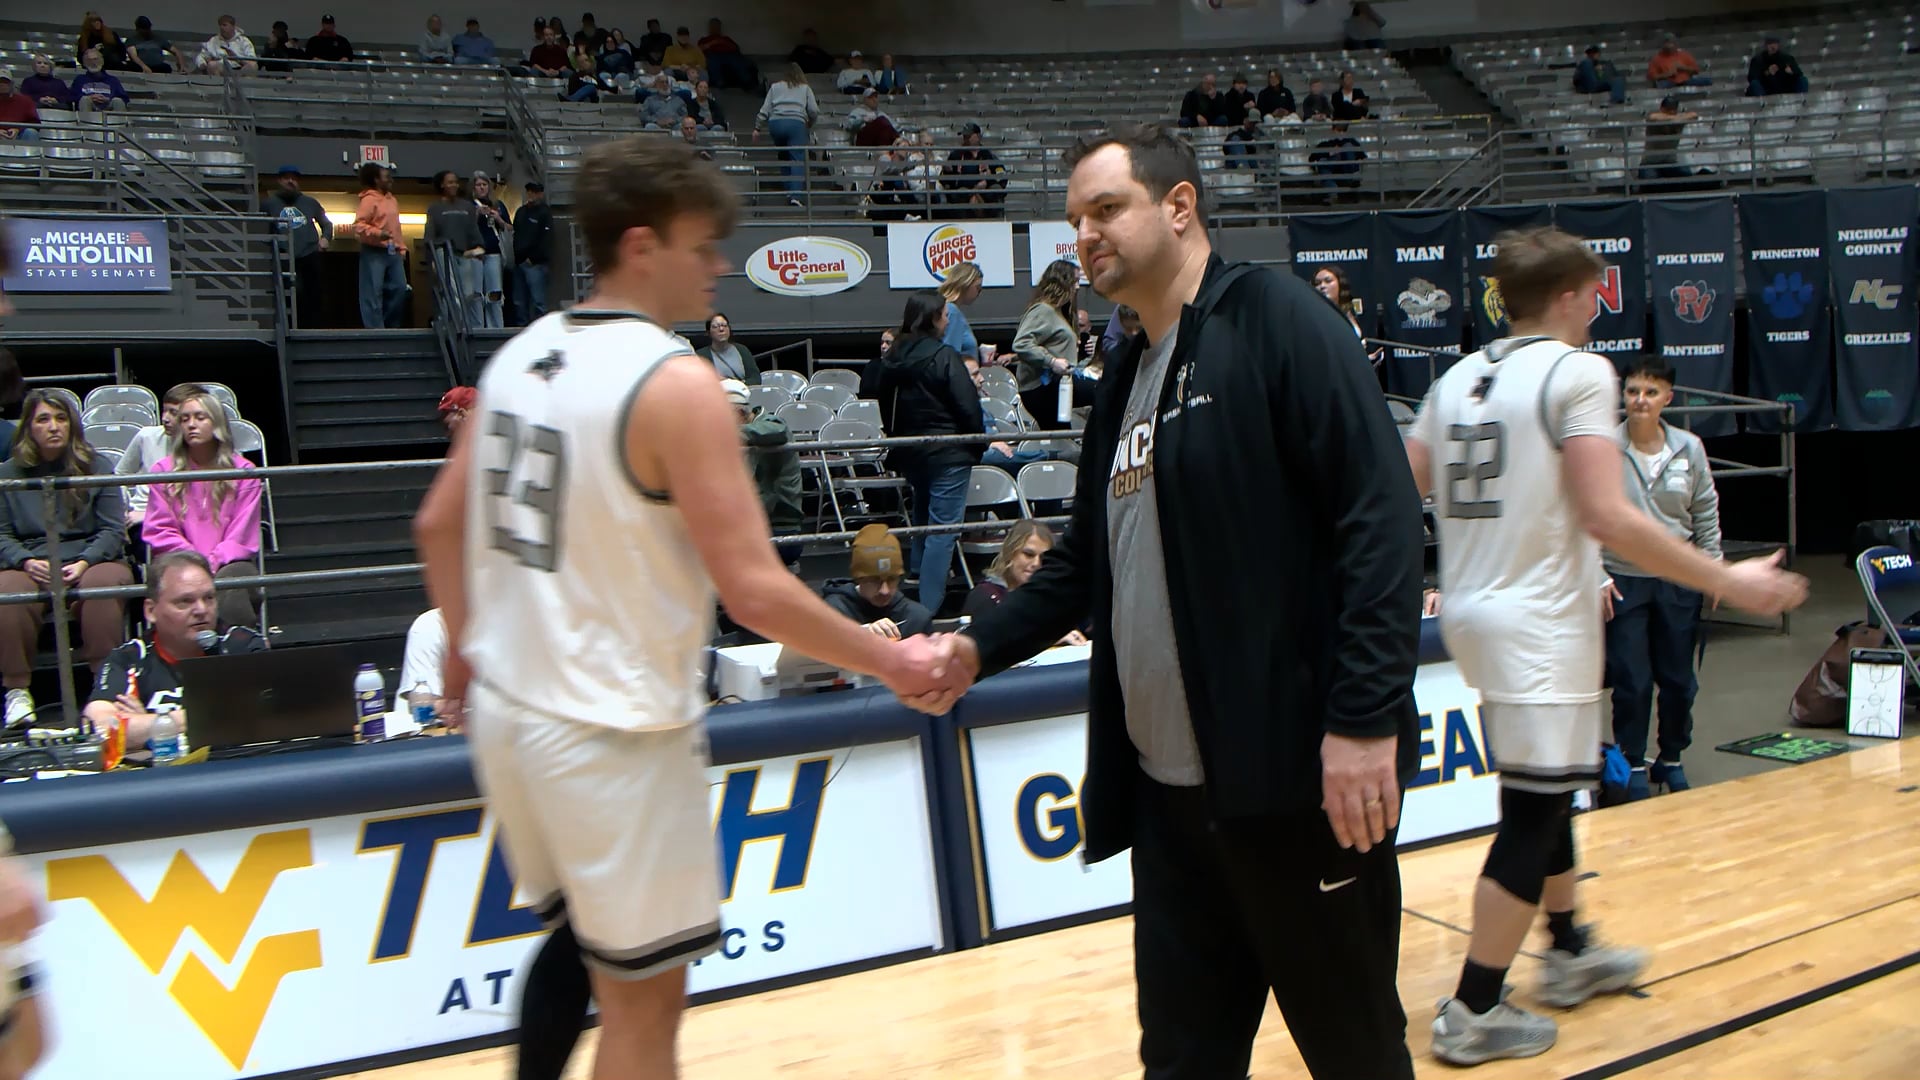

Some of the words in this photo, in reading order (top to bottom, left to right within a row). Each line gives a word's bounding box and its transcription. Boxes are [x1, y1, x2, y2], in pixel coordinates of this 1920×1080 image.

[365, 147, 385, 161] EXIT
[30, 237, 44, 245] DR.
[46, 232, 125, 245] MICHAEL
[1837, 227, 1909, 242] NICHOLAS
[929, 234, 975, 257] BURGER
[1476, 244, 1499, 259] LO
[1844, 243, 1903, 256] COUNTY
[25, 246, 153, 264] ANTOLINI
[767, 250, 808, 271] Little
[932, 245, 977, 273] KING
[1297, 248, 1368, 263] SHERMAN
[1396, 245, 1445, 262] MAN
[1656, 254, 1688, 265] PIKE
[1690, 252, 1724, 264] VIEW
[1751, 247, 1820, 260] PRINCETON
[26, 269, 78, 277] STATE
[91, 269, 156, 277] SENATE
[779, 259, 845, 286] General
[1849, 279, 1903, 309] NC
[1766, 330, 1810, 342] TIGERS
[1844, 331, 1911, 346] GRIZZLIES
[1582, 337, 1642, 352] ILDCATS
[1445, 421, 1507, 519] 22
[1883, 555, 1912, 570] TECH
